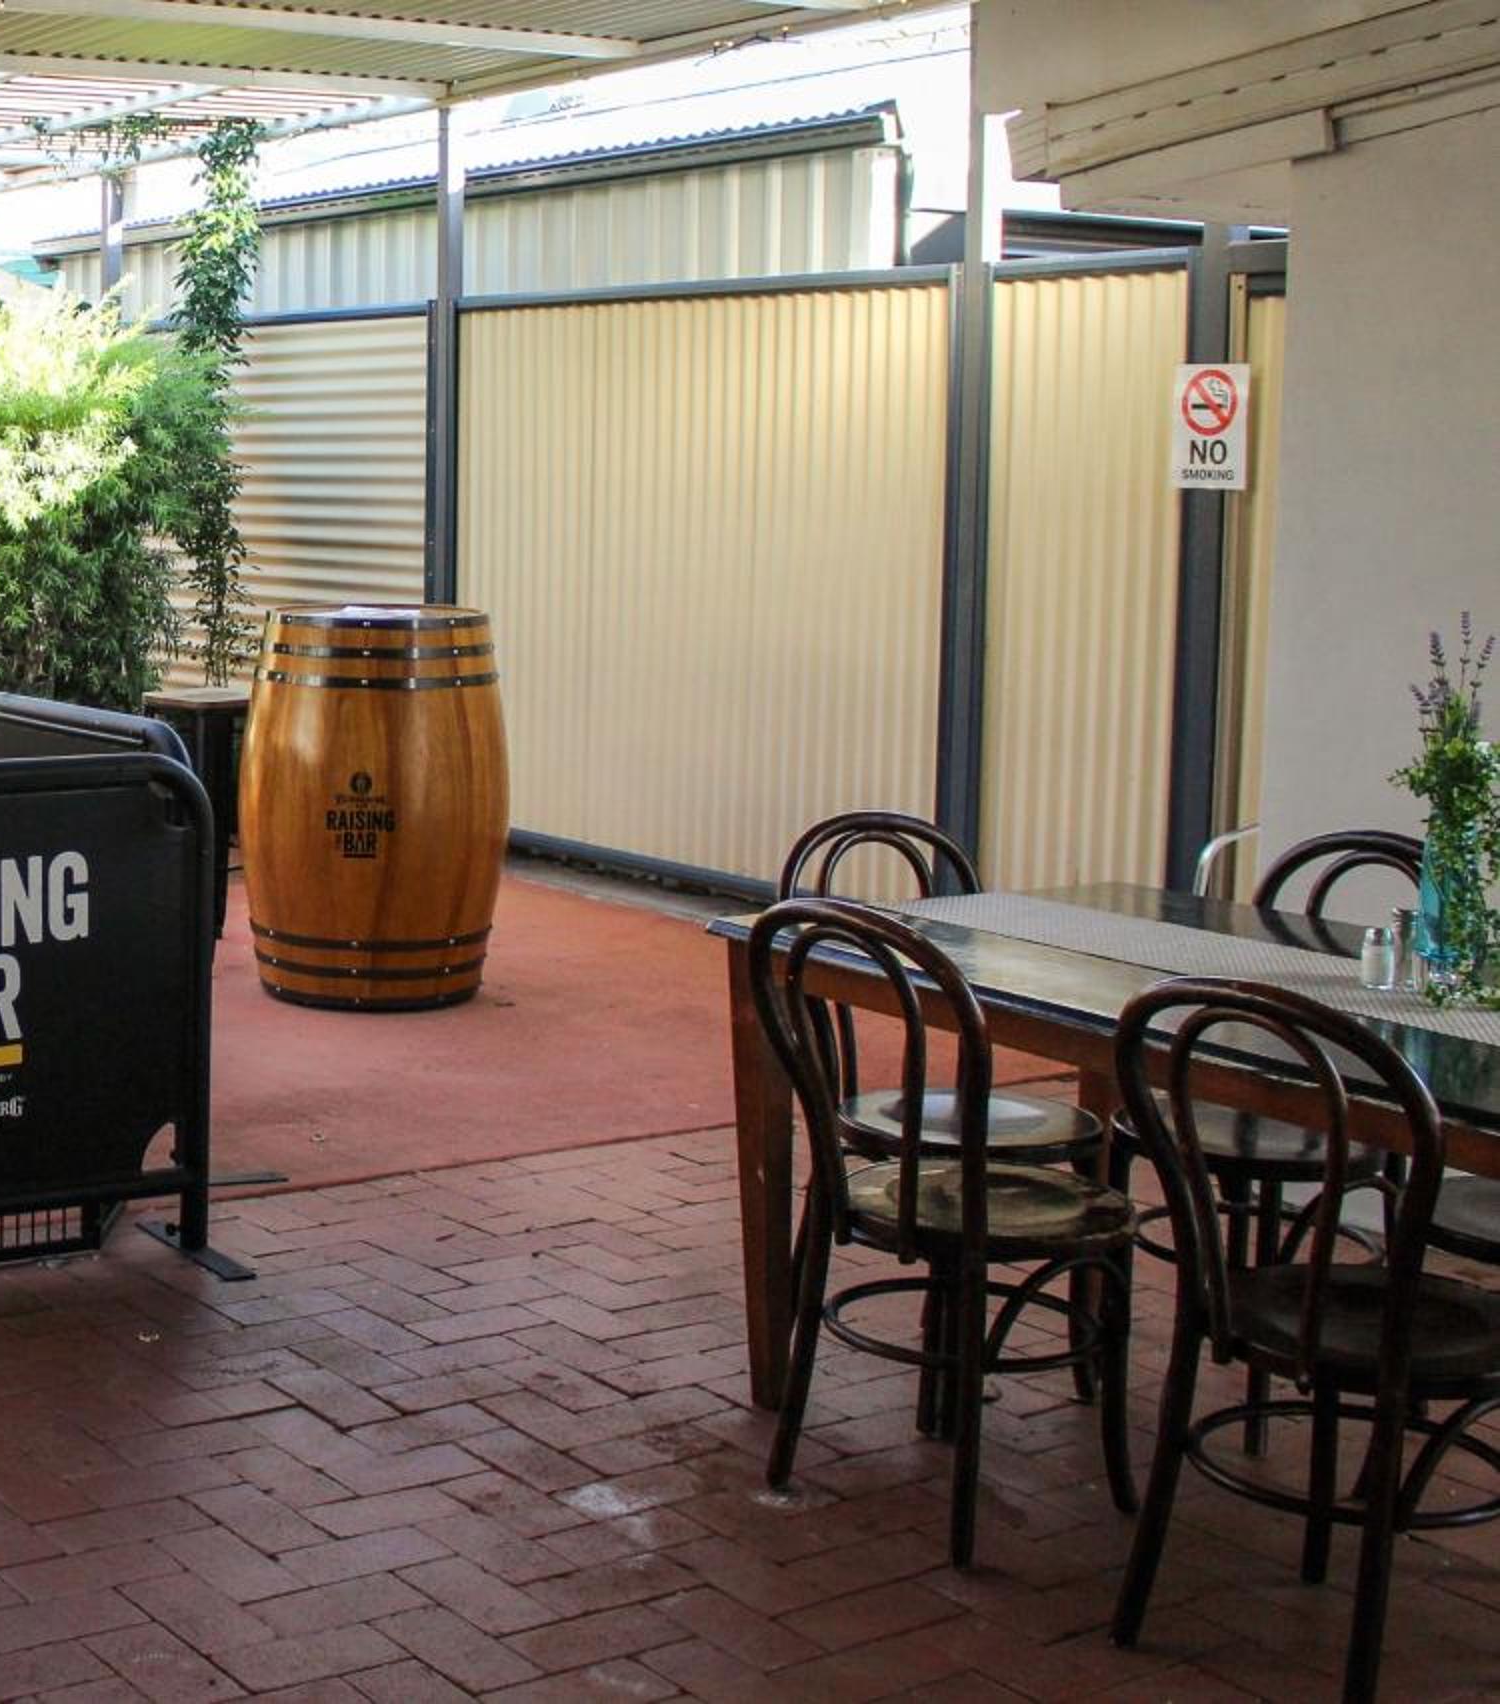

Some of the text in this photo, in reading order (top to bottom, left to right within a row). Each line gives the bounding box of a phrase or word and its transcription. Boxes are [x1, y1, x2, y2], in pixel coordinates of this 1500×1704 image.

[1190, 439, 1227, 465] NO
[1181, 468, 1235, 481] SMOKING
[325, 810, 396, 832] RAISING
[344, 831, 377, 853] BAR
[0, 1073, 13, 1083] BY
